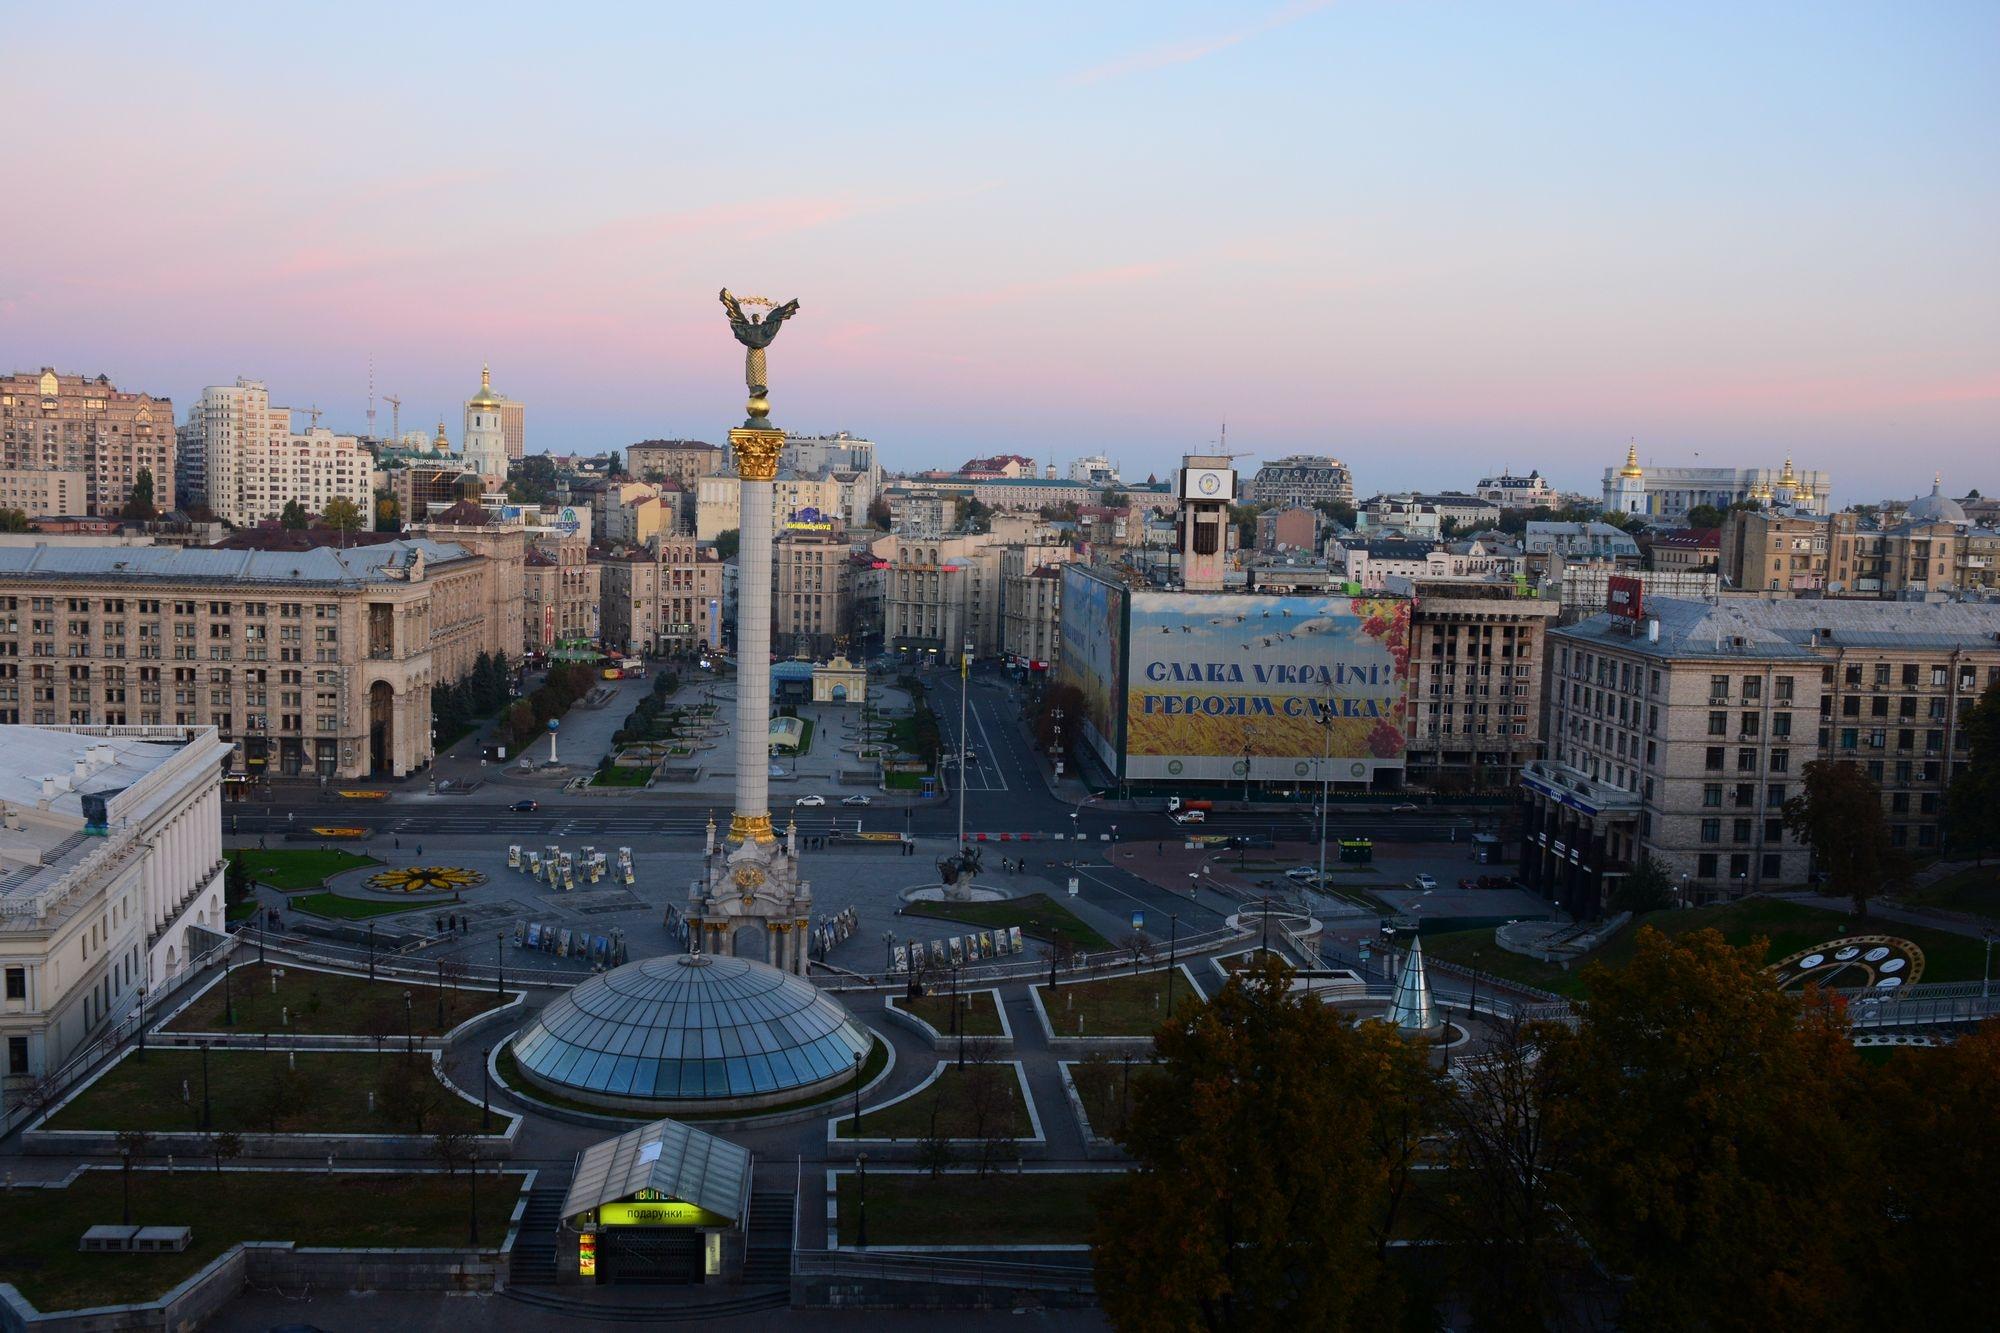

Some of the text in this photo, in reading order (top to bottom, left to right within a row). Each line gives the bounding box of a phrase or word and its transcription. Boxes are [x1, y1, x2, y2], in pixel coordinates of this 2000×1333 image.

[1146, 661, 1391, 685] СЛАВА УКРАЇНІ!
[1143, 695, 1392, 718] ГЕРОЯМ СЛАВА!
[627, 1209, 682, 1220] подарунки
